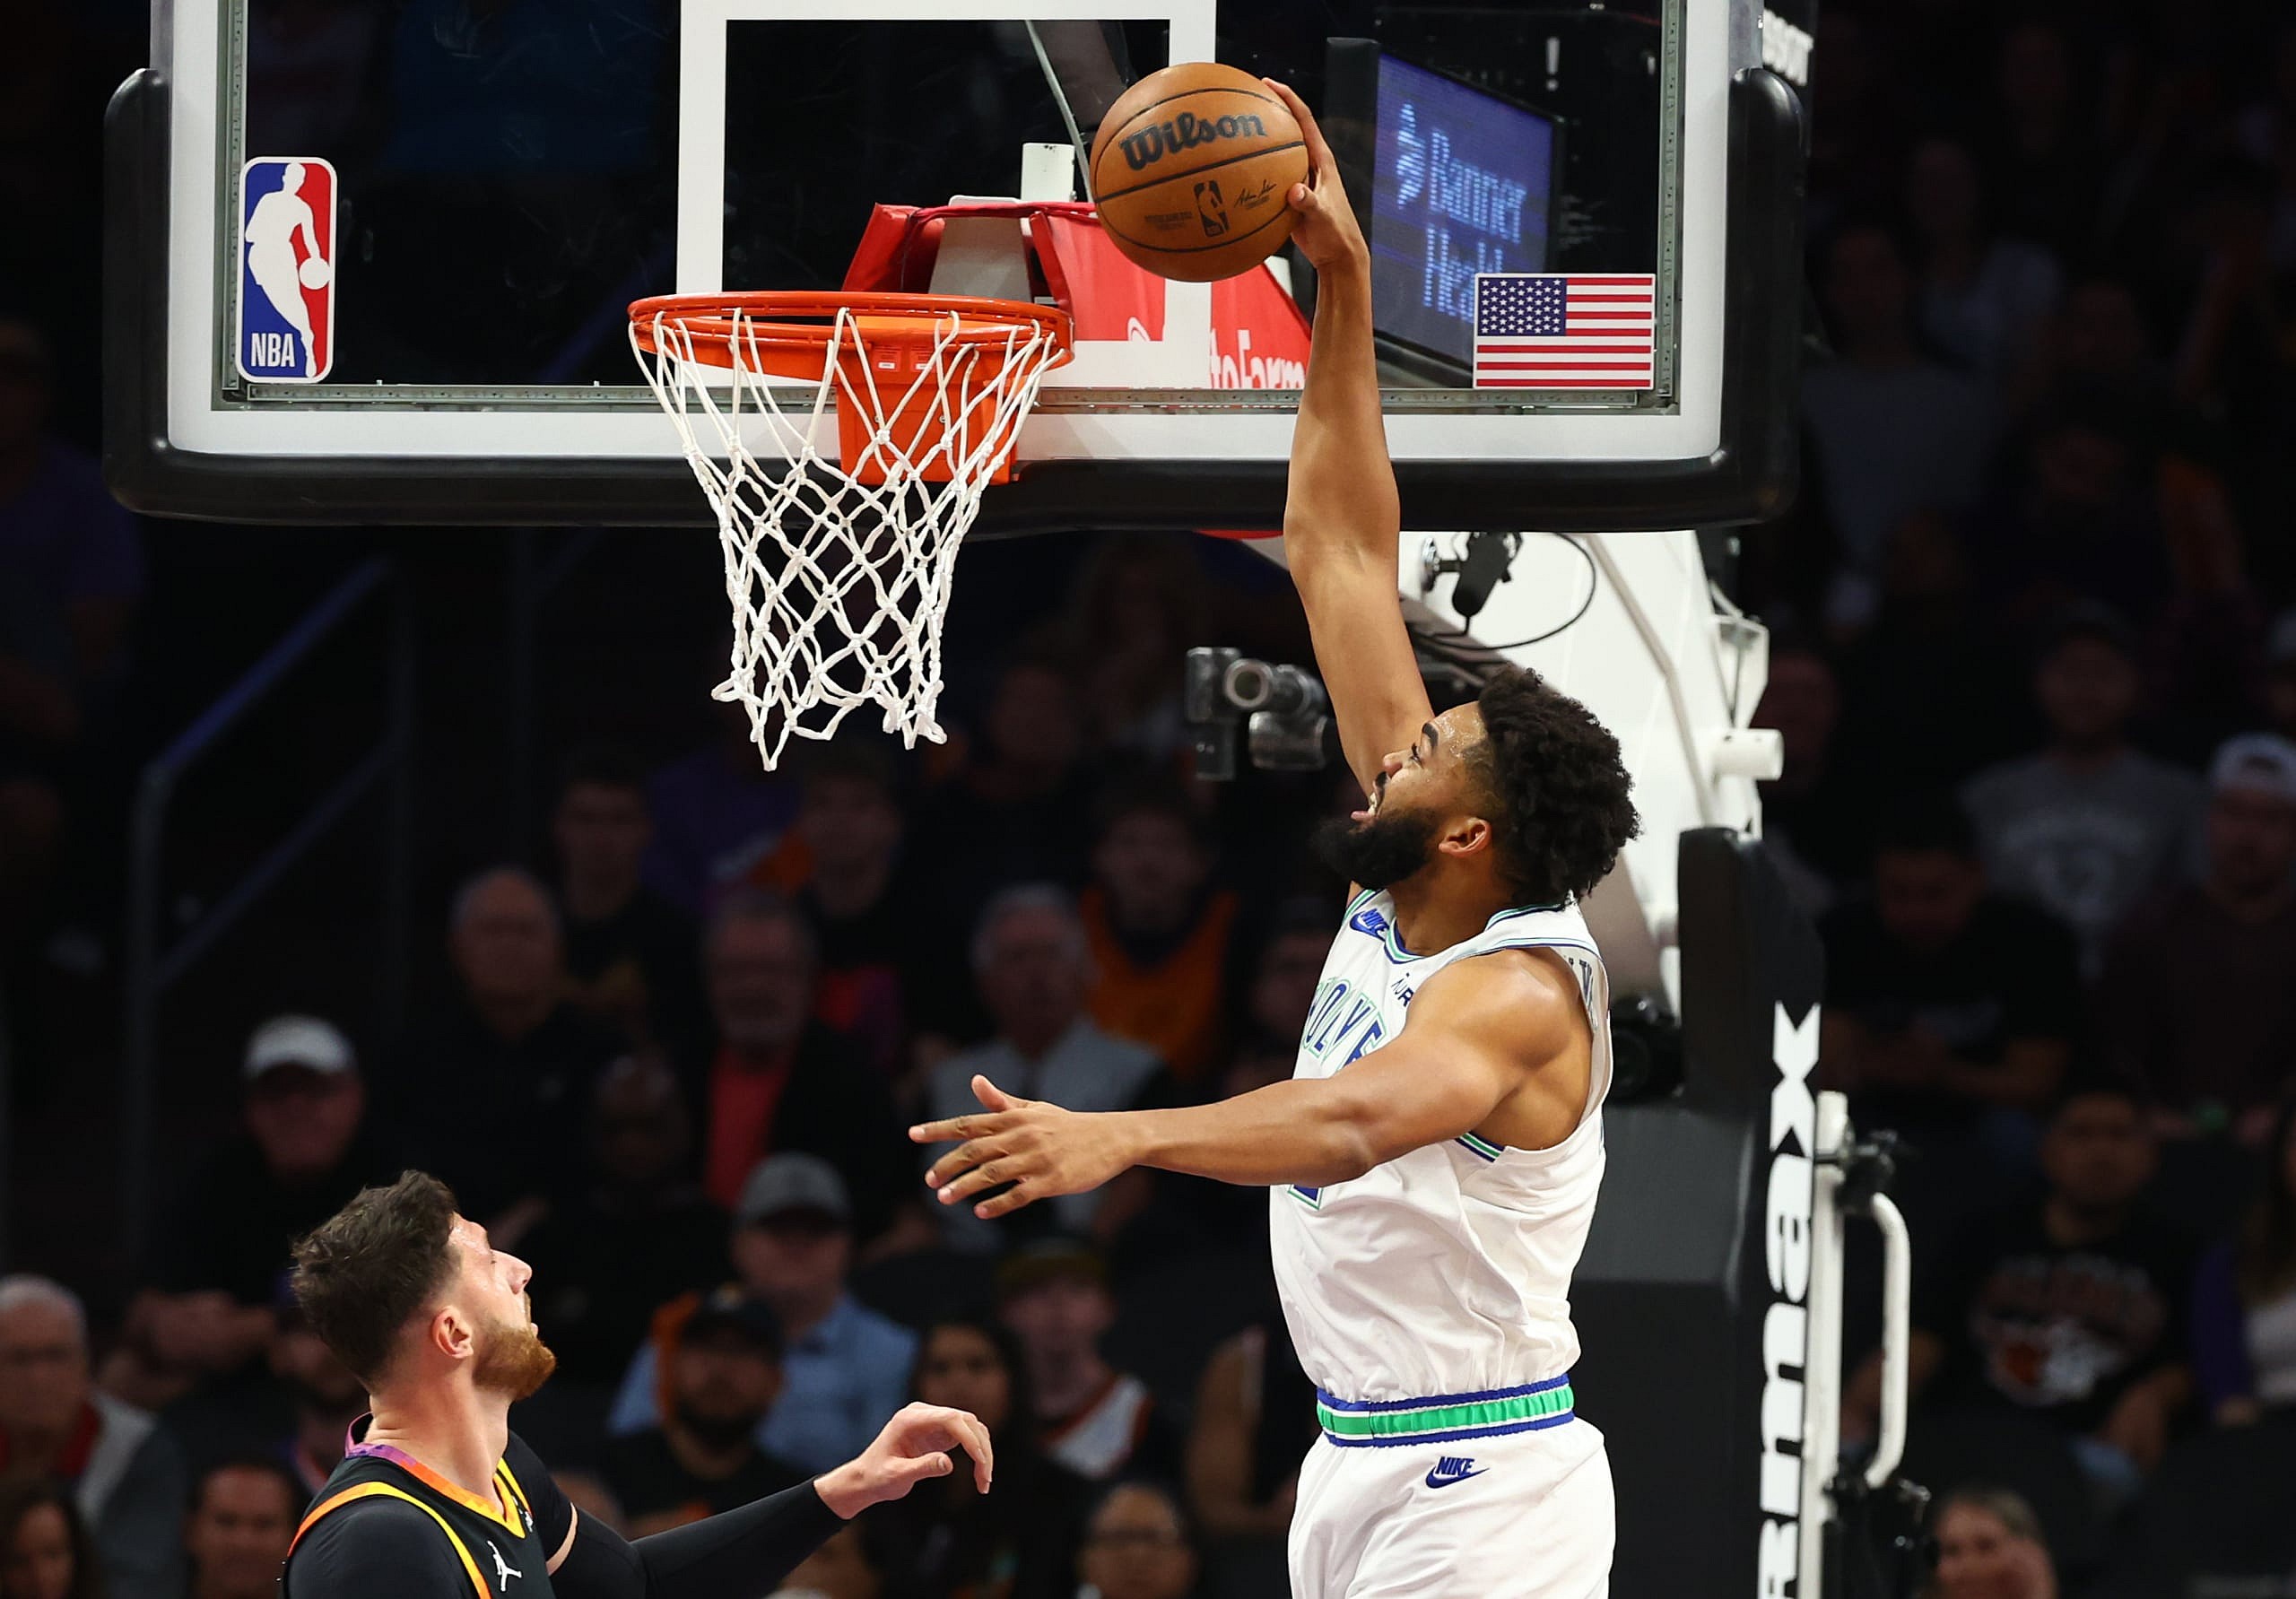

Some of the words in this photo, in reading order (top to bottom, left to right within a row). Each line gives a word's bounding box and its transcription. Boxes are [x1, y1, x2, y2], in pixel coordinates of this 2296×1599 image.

[1119, 112, 1267, 170] Wilson
[1430, 127, 1526, 244] Banner
[251, 333, 295, 368] NBA
[1435, 1456, 1474, 1476] NIKE
